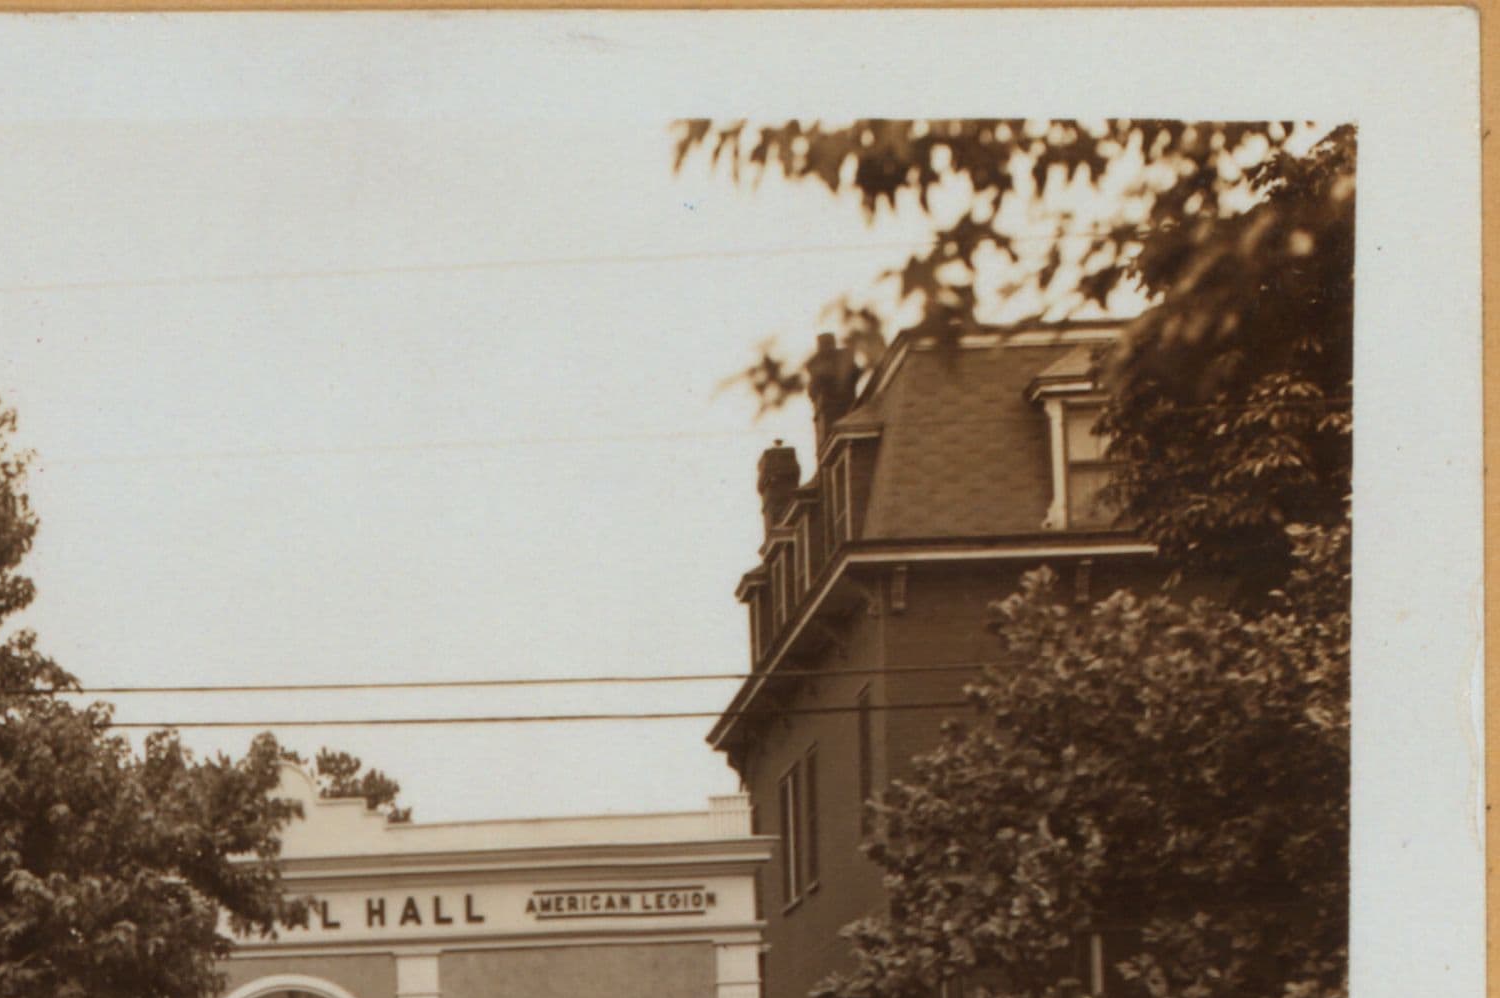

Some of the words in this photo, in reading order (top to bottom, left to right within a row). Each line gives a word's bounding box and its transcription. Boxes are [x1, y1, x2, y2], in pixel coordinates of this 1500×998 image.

[366, 893, 485, 928] HALL
[525, 894, 631, 914] AMERICAN
[641, 892, 717, 911] LEGION
